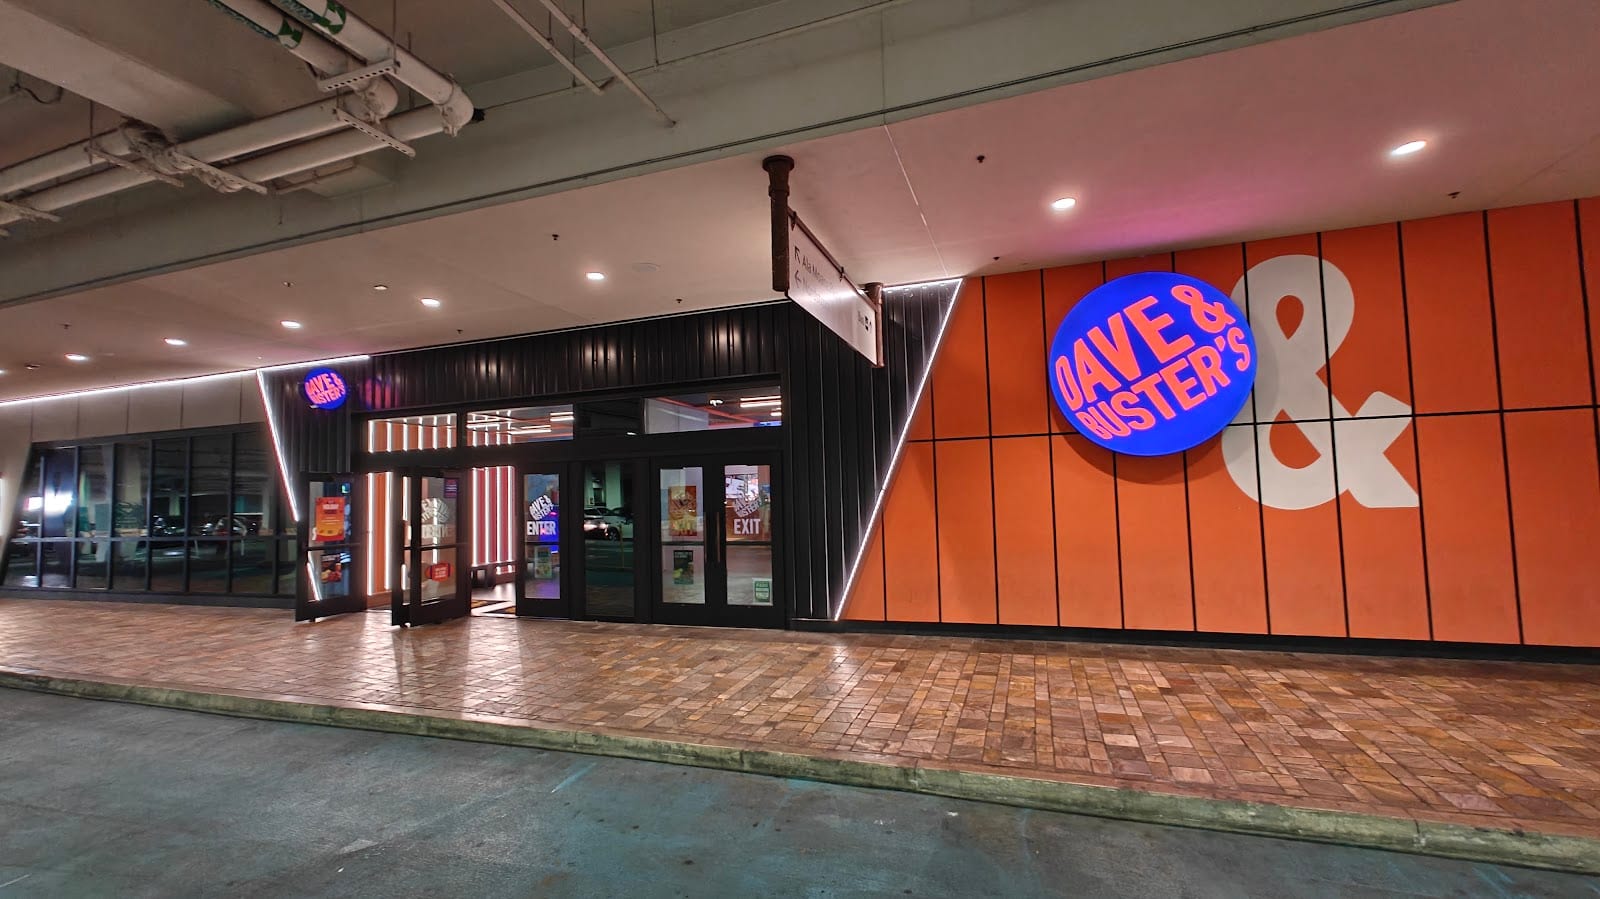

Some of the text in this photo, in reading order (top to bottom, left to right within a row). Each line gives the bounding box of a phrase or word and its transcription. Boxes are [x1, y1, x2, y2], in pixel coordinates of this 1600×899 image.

[1055, 284, 1236, 411] DAVE &
[305, 373, 334, 394] DAVE
[1075, 327, 1250, 440] BUSTER'S
[1221, 254, 1420, 510] &
[527, 520, 556, 535] ENTER
[734, 518, 761, 534] EXIT
